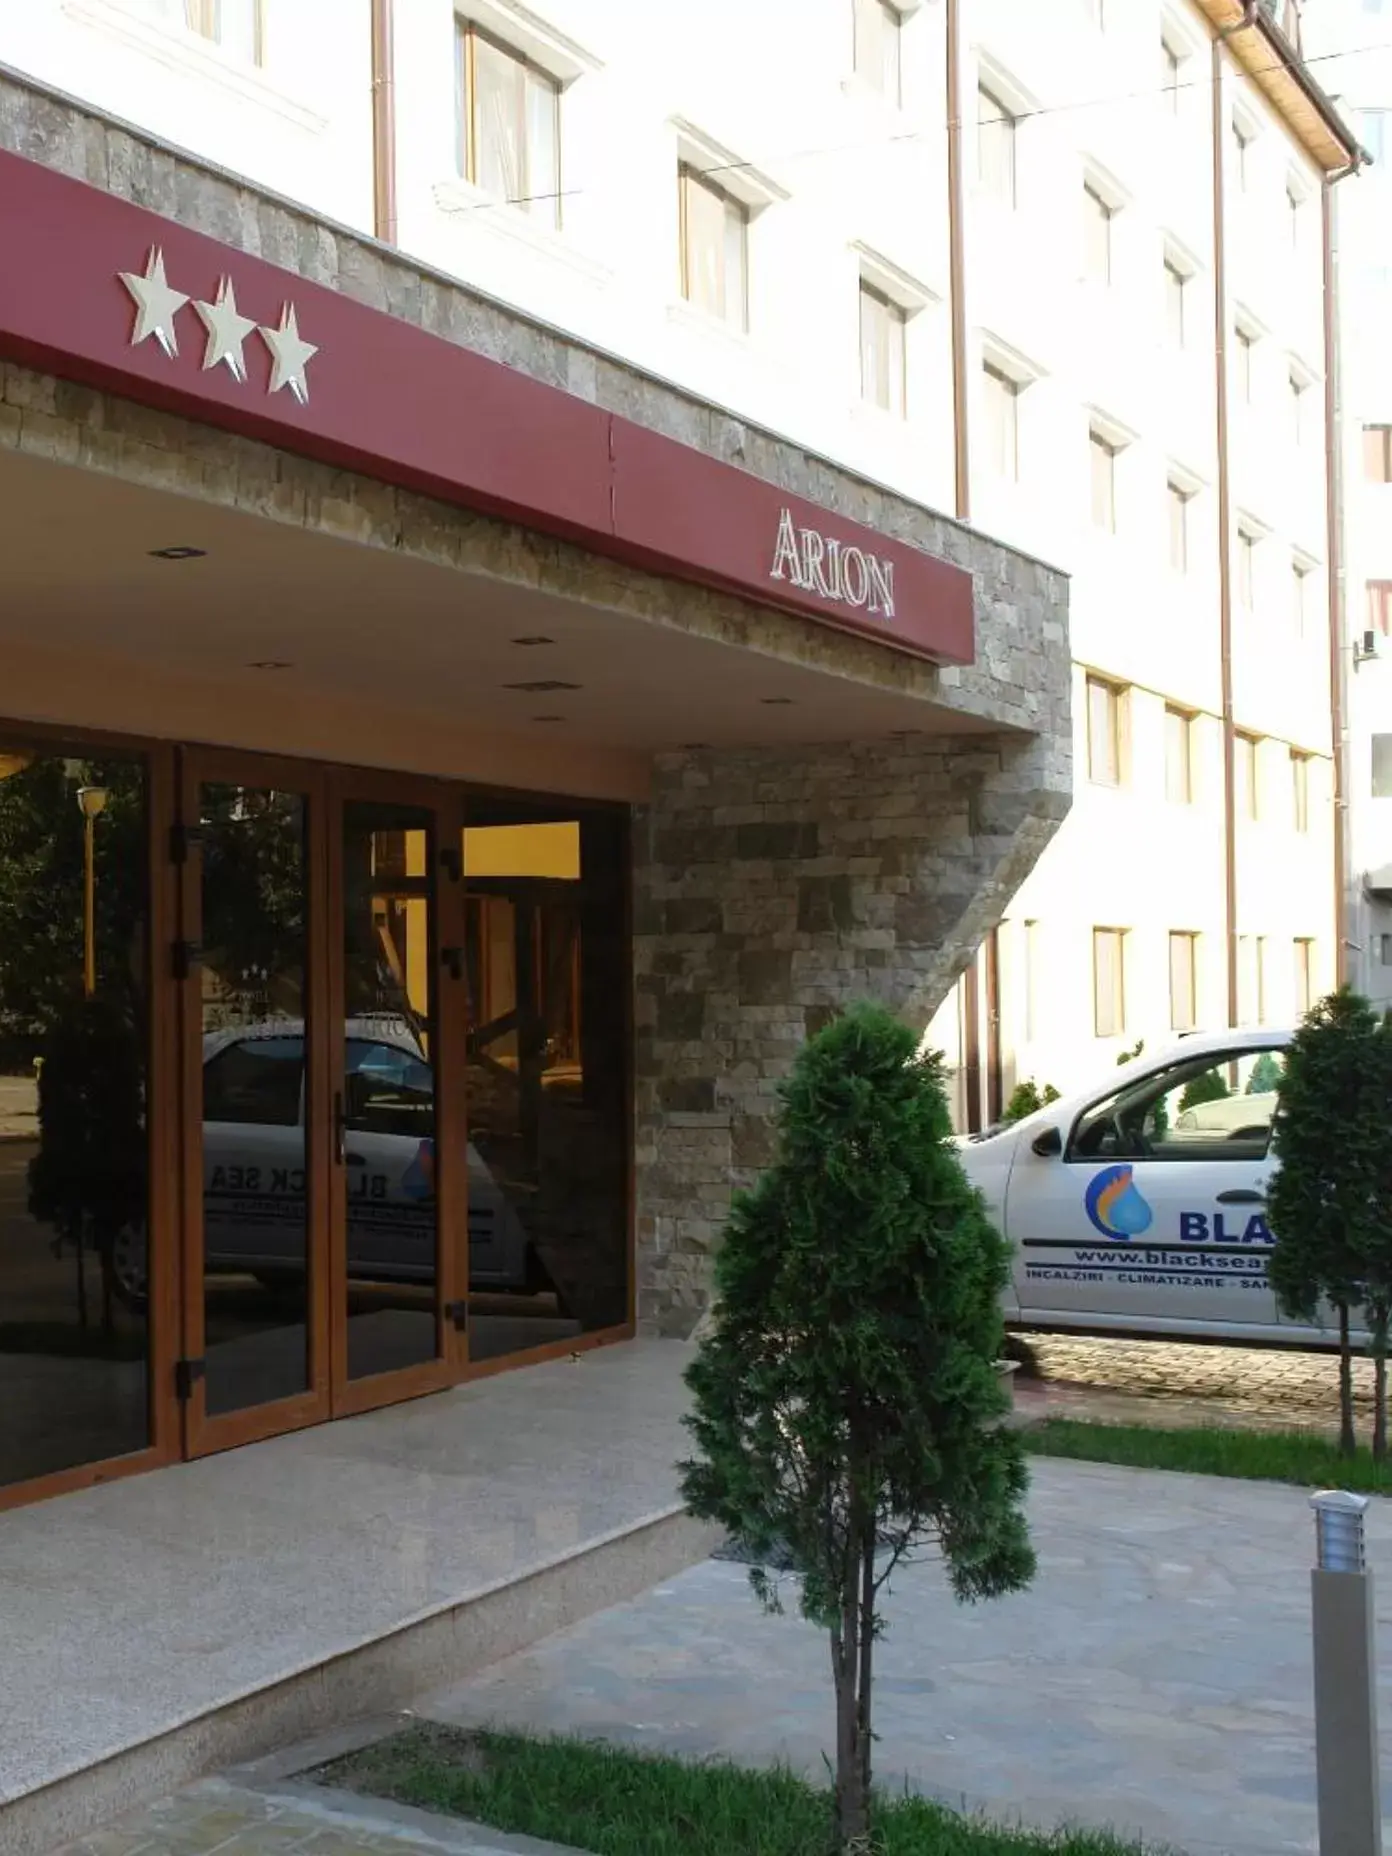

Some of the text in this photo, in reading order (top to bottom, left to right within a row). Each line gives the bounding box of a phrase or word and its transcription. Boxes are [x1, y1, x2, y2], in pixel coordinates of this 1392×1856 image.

[769, 507, 895, 617] ARION
[1180, 1211, 1276, 1244] BLA
[1117, 1272, 1225, 1288] CLIMATIZARE
